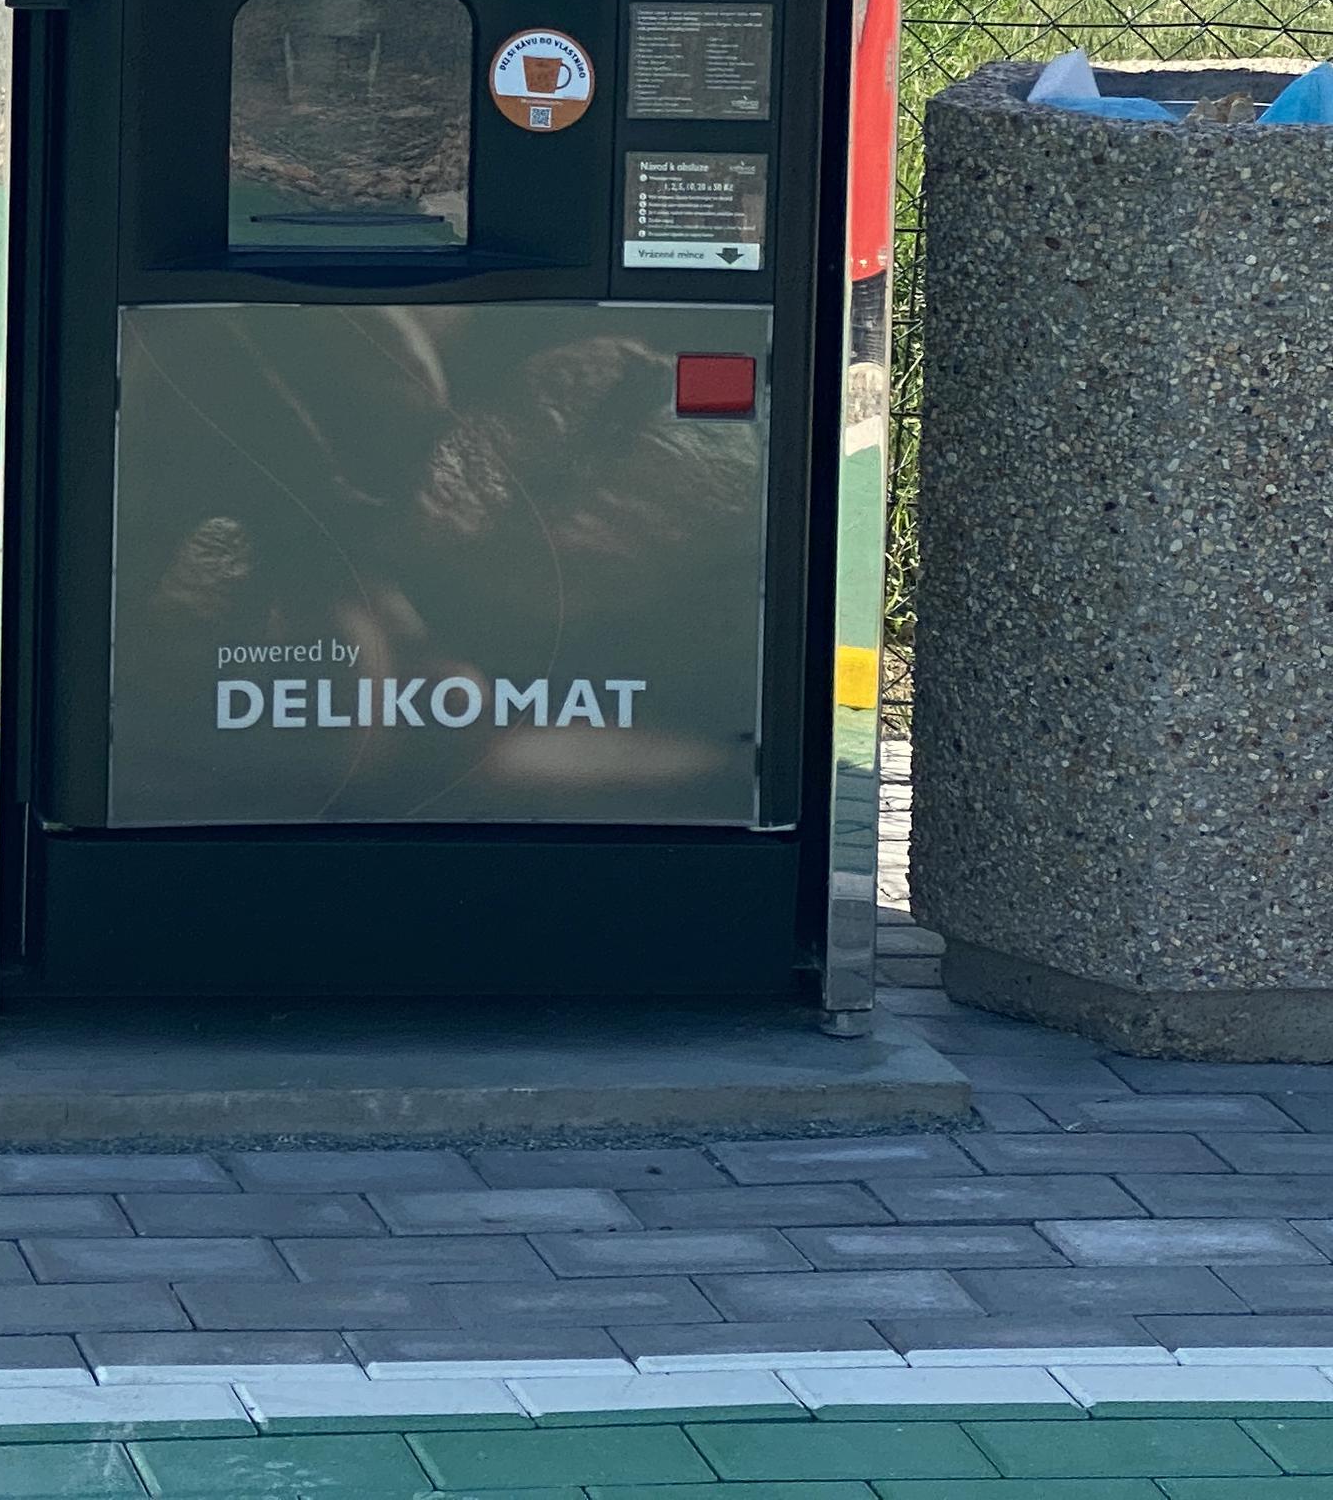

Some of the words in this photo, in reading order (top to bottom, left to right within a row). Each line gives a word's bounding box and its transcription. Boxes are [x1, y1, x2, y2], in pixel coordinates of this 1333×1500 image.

[217, 640, 322, 668] powered
[331, 639, 360, 668] by
[216, 677, 647, 730] DELIKOMAT
